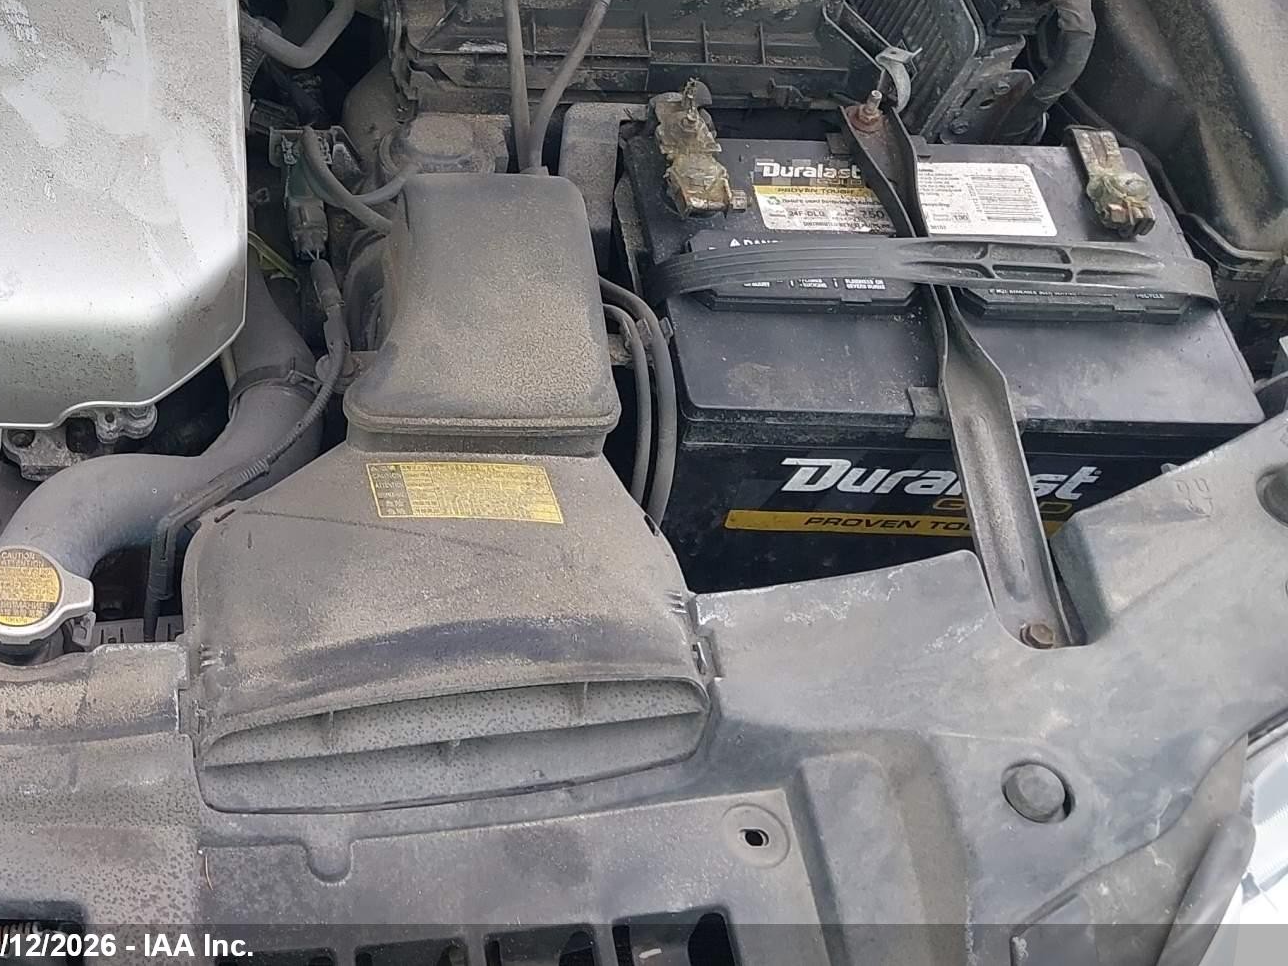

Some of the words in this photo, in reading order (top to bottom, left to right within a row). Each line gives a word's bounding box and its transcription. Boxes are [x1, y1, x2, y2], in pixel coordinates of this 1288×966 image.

[756, 162, 861, 179] Duralast
[781, 457, 1100, 500] Durast
[804, 516, 921, 530] PROVEN
